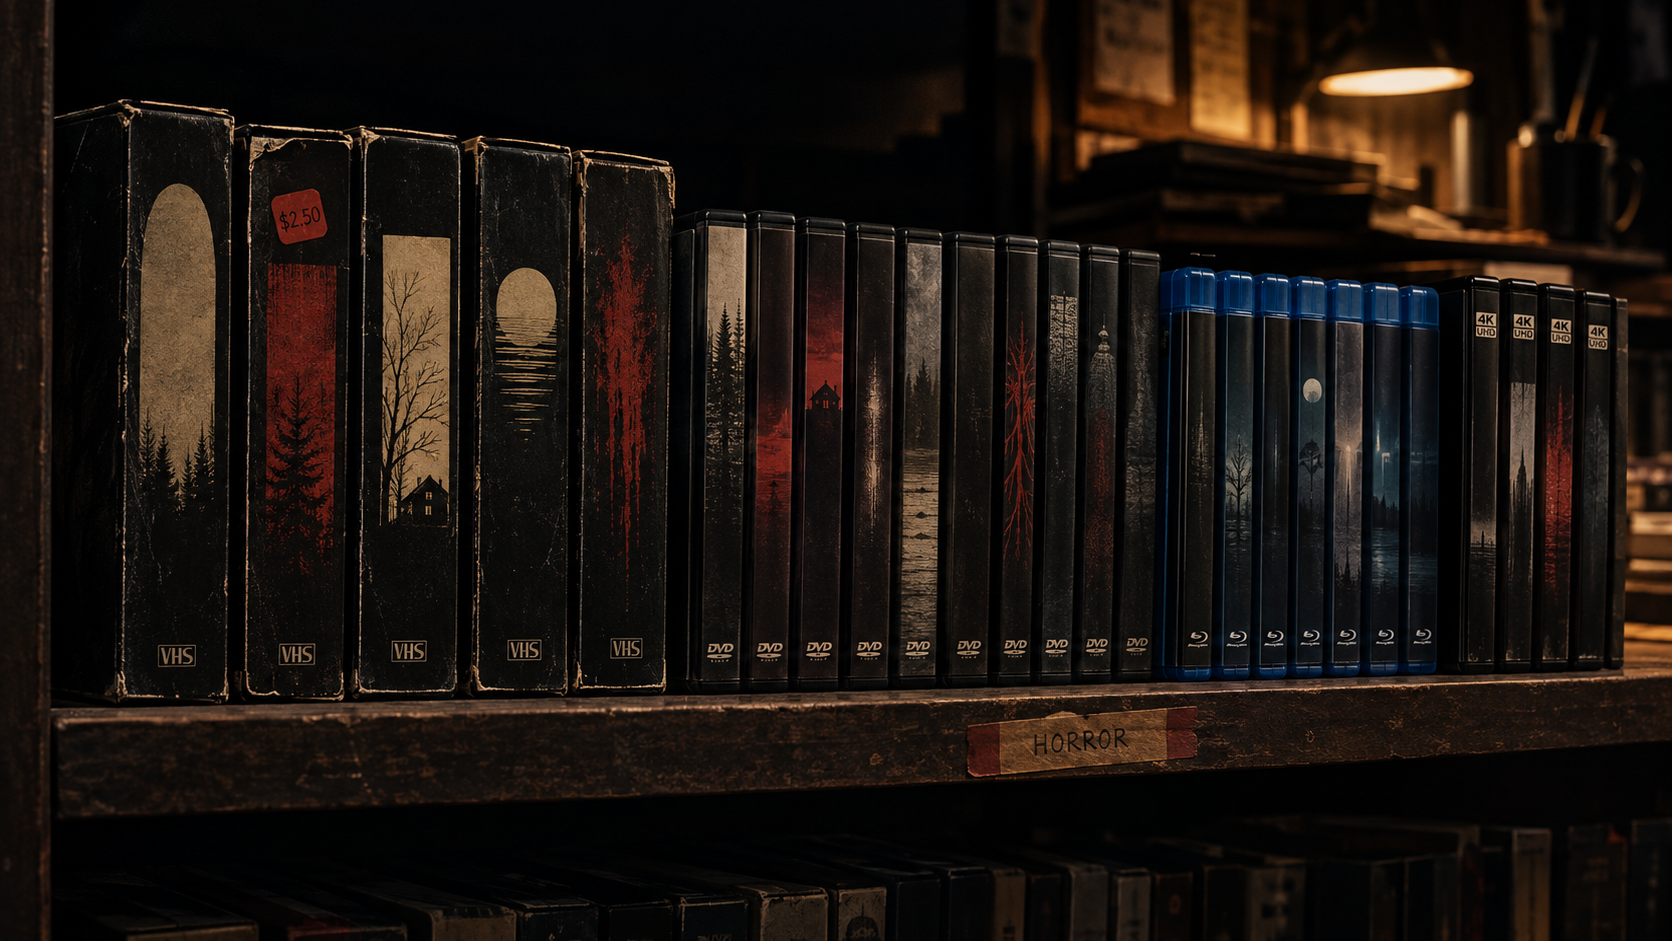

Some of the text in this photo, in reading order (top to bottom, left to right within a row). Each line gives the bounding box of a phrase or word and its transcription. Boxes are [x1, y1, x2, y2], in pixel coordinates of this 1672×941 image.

[279, 205, 321, 233] $2.50
[1477, 314, 1494, 326] 4K
[1515, 315, 1532, 327] 4K
[1553, 321, 1569, 332] 4K
[1476, 328, 1496, 337] UHD
[1514, 329, 1533, 339] UHD
[1590, 327, 1606, 338] 4K
[1552, 333, 1571, 343] UHD
[1589, 339, 1607, 349] UHD
[757, 642, 783, 652] DVD
[806, 641, 832, 651] DVD
[857, 641, 882, 651] DVD
[906, 641, 931, 651] DVD
[957, 640, 982, 650] DVD
[1005, 639, 1028, 649] DVD
[1046, 639, 1069, 649] DVD
[1086, 638, 1109, 648] DVD
[1127, 637, 1149, 647] DVD
[394, 643, 425, 660] VHS
[510, 641, 539, 658] VHS
[613, 640, 641, 656] VHS
[707, 643, 734, 653] DVD
[160, 647, 194, 665] VHS
[281, 645, 313, 663] VHS
[1034, 728, 1129, 756] HORROR
